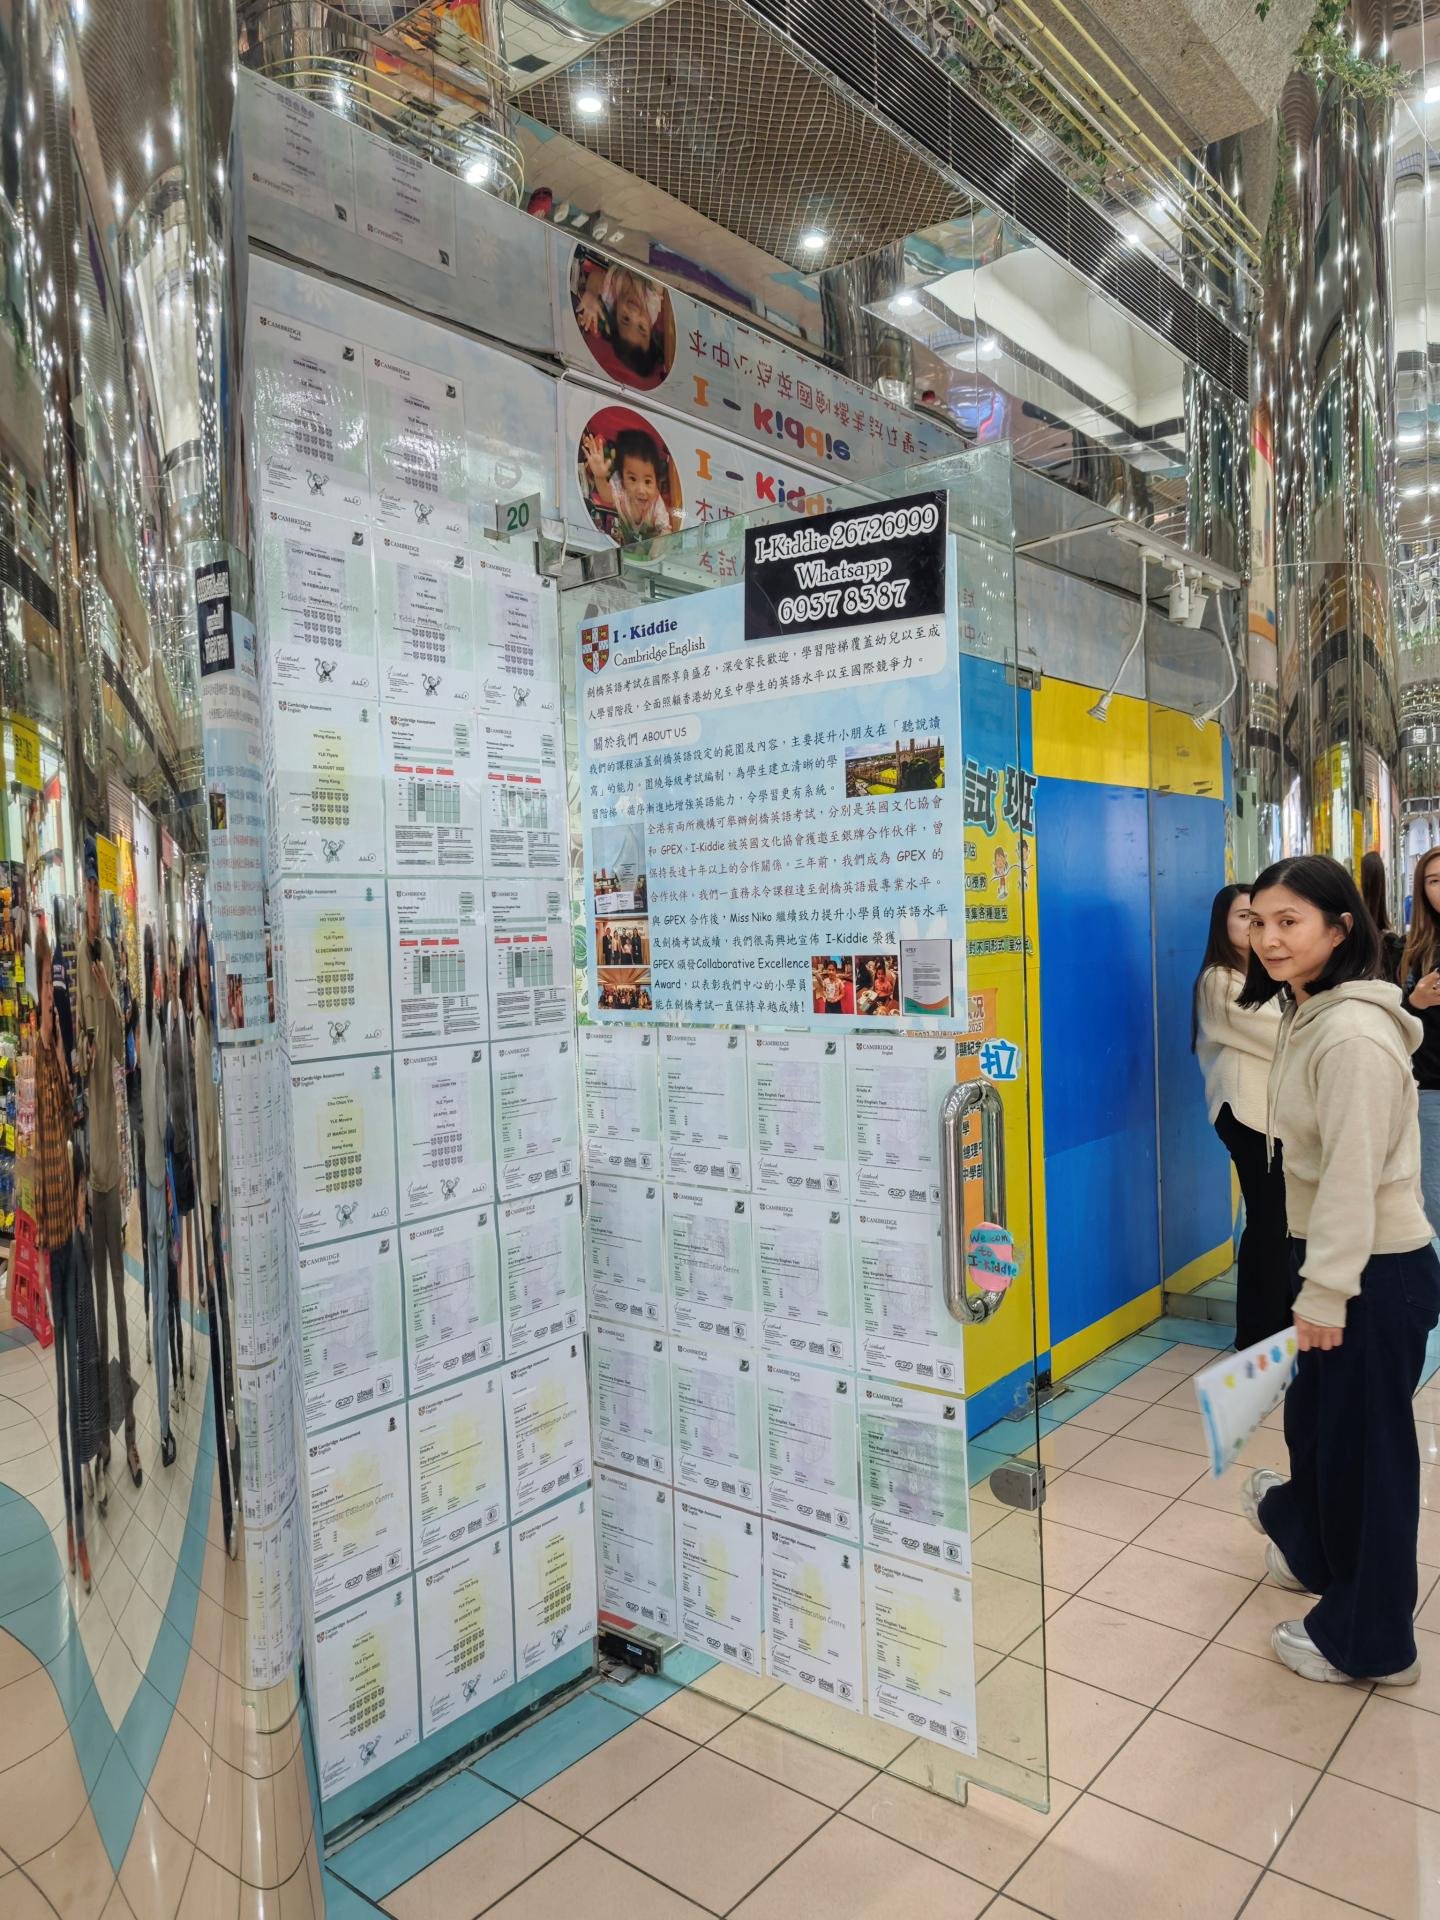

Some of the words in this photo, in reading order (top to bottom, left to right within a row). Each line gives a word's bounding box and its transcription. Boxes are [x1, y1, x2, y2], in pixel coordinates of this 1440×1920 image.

[695, 448, 713, 481] I
[756, 471, 843, 516] Kiddi
[507, 502, 529, 531] 20
[755, 528, 830, 563] I-Kiddie
[831, 503, 938, 546] 26726999
[795, 558, 891, 590] Whatsapp
[779, 589, 843, 624] 6937
[843, 580, 910, 612] 8387
[630, 619, 678, 641] Kiddie
[614, 646, 667, 667] Cambridge
[669, 637, 706, 656] English
[593, 732, 638, 751] 關於我們
[642, 729, 672, 743] ABOUT
[674, 727, 687, 737] US
[691, 840, 725, 853] I-Kiddie
[897, 850, 926, 863] GPEX
[932, 848, 944, 862] 的
[663, 914, 686, 926] GPEX
[729, 911, 750, 924] Miss
[752, 910, 772, 923] Niko
[826, 932, 869, 946] I-Kiddie
[653, 958, 675, 970] GPEX
[758, 957, 810, 969] Excellence
[980, 1040, 1017, 1079] 拉
